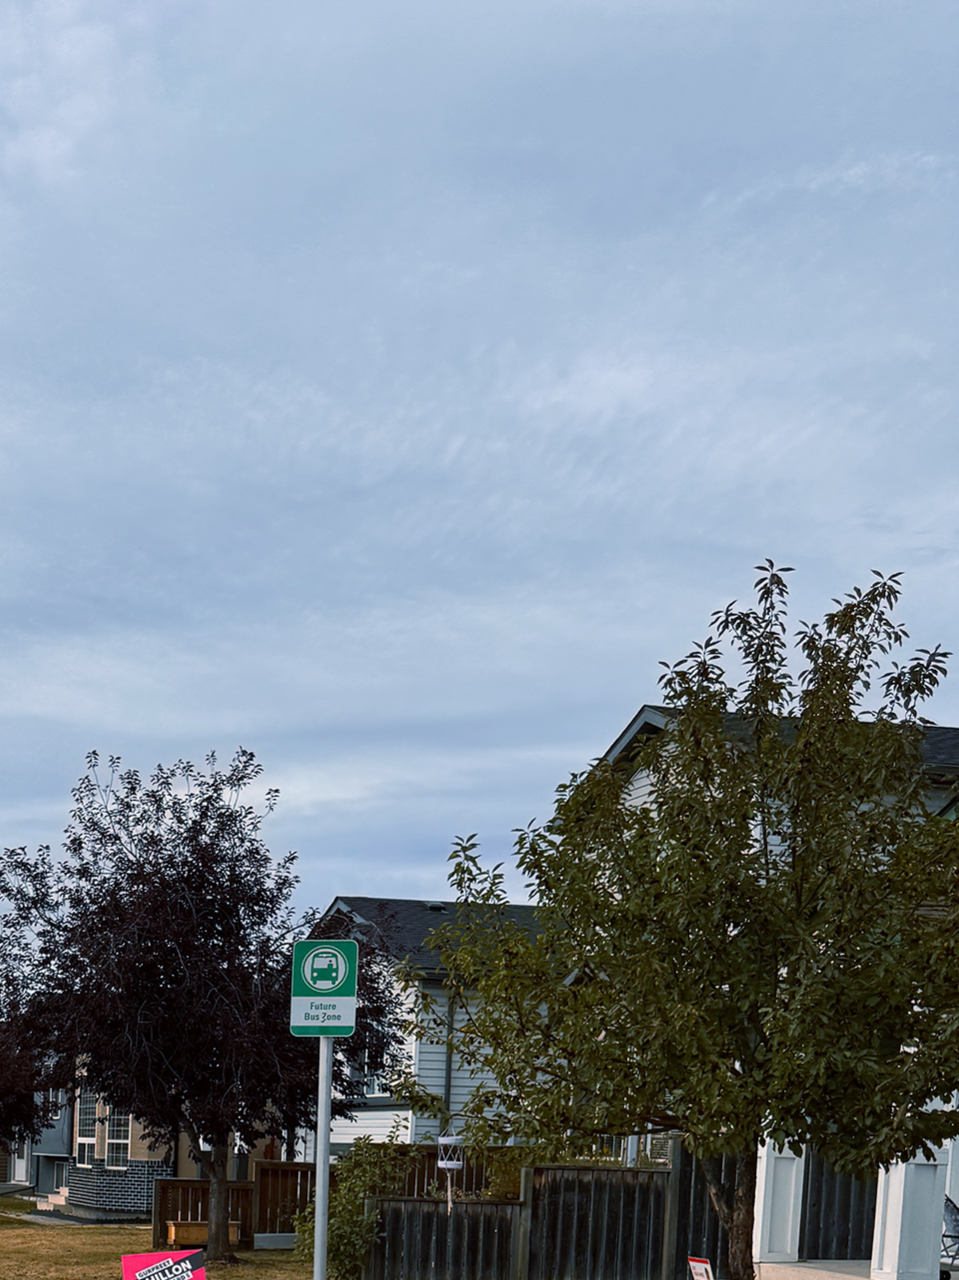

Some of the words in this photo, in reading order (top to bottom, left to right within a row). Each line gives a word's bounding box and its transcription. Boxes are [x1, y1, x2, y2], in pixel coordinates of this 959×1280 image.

[310, 1002, 337, 1011] Future
[304, 1012, 319, 1021] Bus
[321, 1012, 342, 1022] Zone
[138, 1260, 171, 1278] GURPREET
